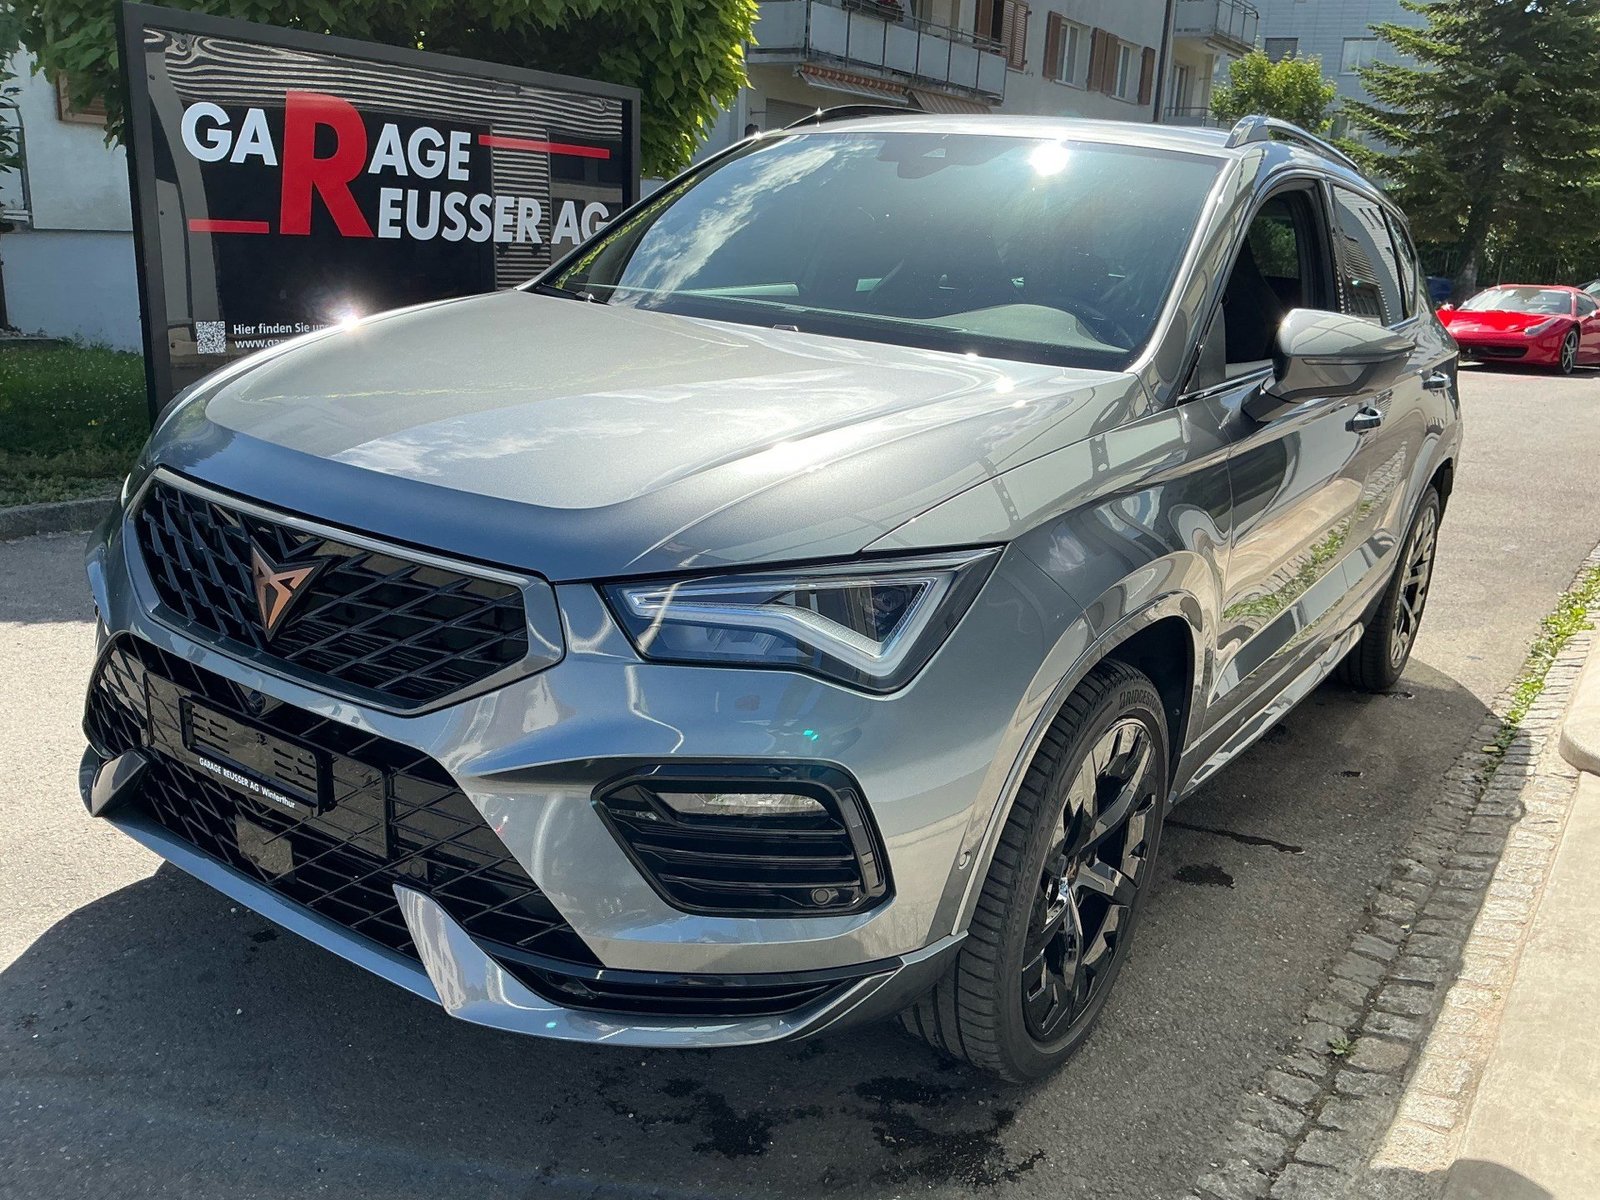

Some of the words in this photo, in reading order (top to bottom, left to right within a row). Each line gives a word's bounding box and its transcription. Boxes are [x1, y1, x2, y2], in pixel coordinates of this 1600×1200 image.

[180, 89, 472, 238] GARAGE
[551, 200, 610, 245] AG
[233, 323, 256, 335] Hier
[258, 322, 292, 335] finden
[295, 322, 310, 333] Sie
[199, 757, 222, 774] GARAGE
[223, 768, 249, 788] REUSSER
[249, 781, 260, 792] AG
[261, 786, 296, 809] Winterthur
